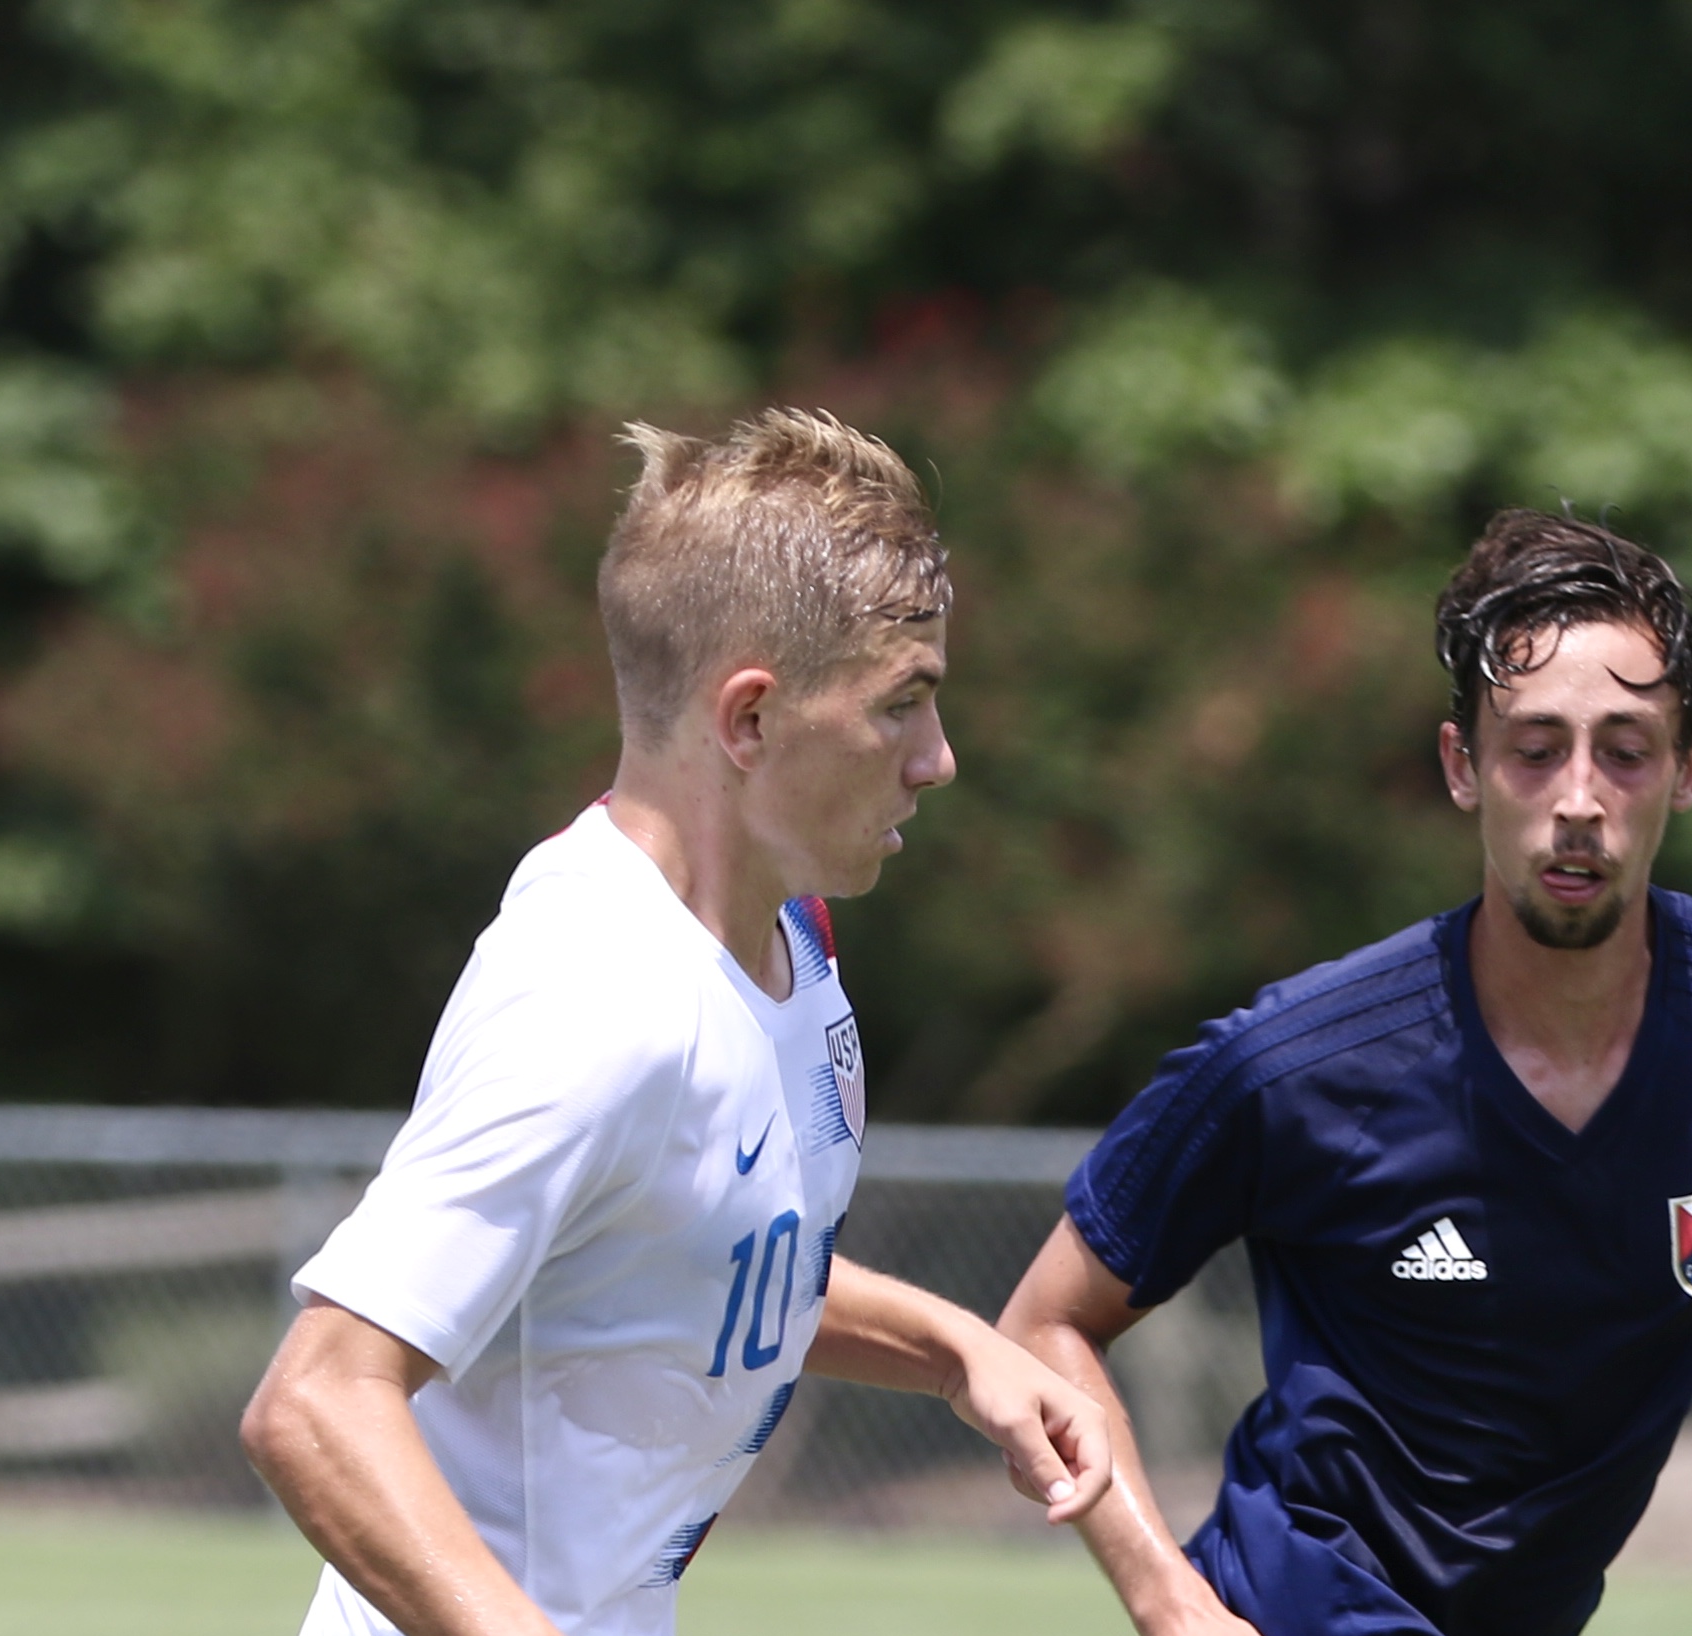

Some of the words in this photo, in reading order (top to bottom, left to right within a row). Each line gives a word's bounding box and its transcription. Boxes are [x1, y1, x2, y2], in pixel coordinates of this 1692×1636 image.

[830, 1022, 858, 1073] USA
[706, 1209, 800, 1377] 10
[1391, 1257, 1488, 1281] adidas
